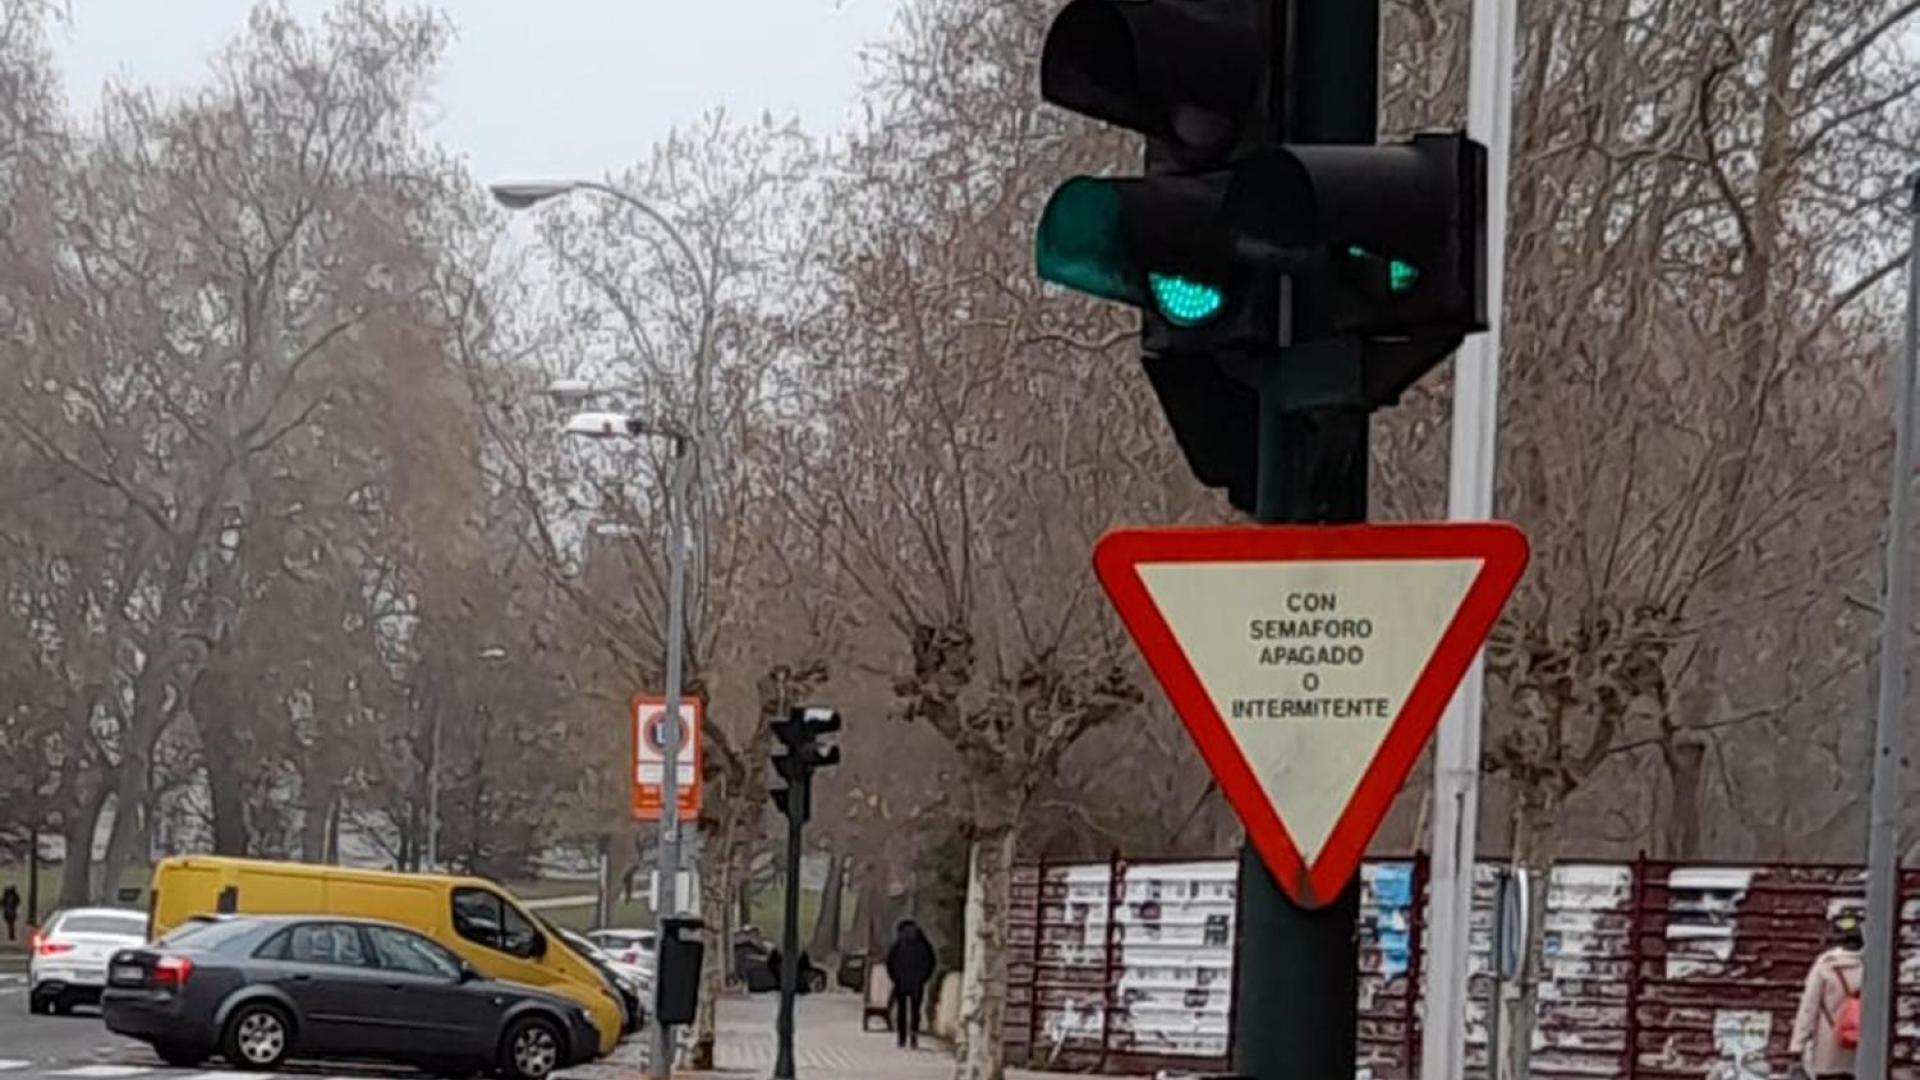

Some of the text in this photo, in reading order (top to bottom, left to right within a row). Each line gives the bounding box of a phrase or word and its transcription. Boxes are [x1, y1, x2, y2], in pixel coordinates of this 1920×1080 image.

[1287, 593, 1337, 612] CON
[1251, 620, 1373, 640] SEMAFORO
[1260, 646, 1364, 665] APAGADO
[1303, 673, 1320, 692] O
[1232, 699, 1390, 718] INTERMITENTE
